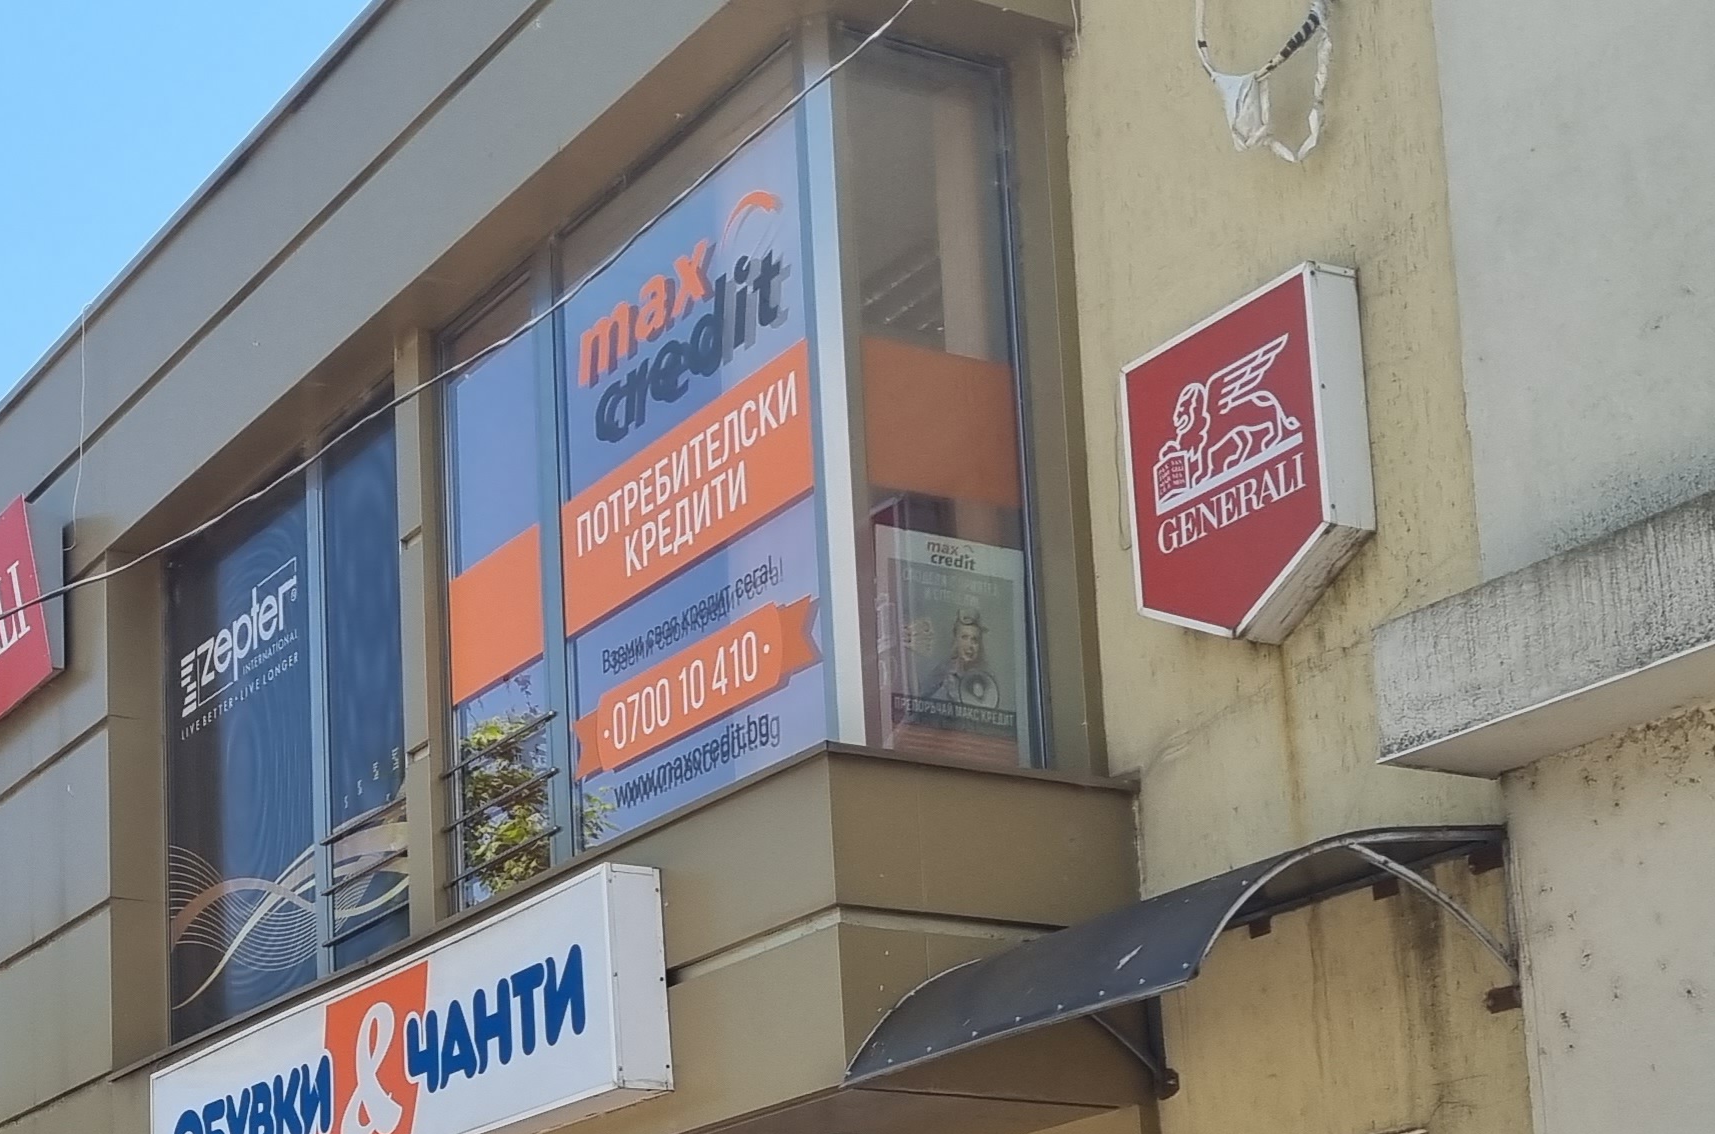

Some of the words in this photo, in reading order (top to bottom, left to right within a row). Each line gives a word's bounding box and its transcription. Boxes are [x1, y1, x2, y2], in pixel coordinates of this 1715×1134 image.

[577, 238, 711, 389] max
[595, 249, 784, 443] credit
[575, 370, 798, 558] ПОТРЕБИТЕЛСКИ
[623, 459, 748, 578] КРЕДИТИ
[1157, 451, 1307, 554] GENERALI
[926, 540, 959, 557] max
[930, 553, 977, 572] credit
[196, 575, 297, 687] zepter
[241, 628, 298, 676] INTERNATIONAL
[180, 719, 201, 741] LIVE
[201, 696, 234, 727] BETTER
[239, 678, 260, 702] LIVE
[262, 651, 299, 685] LONGER
[612, 678, 671, 750] 0700
[678, 659, 705, 716] 10
[711, 631, 759, 696] 410
[614, 712, 780, 808] www.maxcredit.bg
[405, 942, 586, 1094] ЧАНТИ
